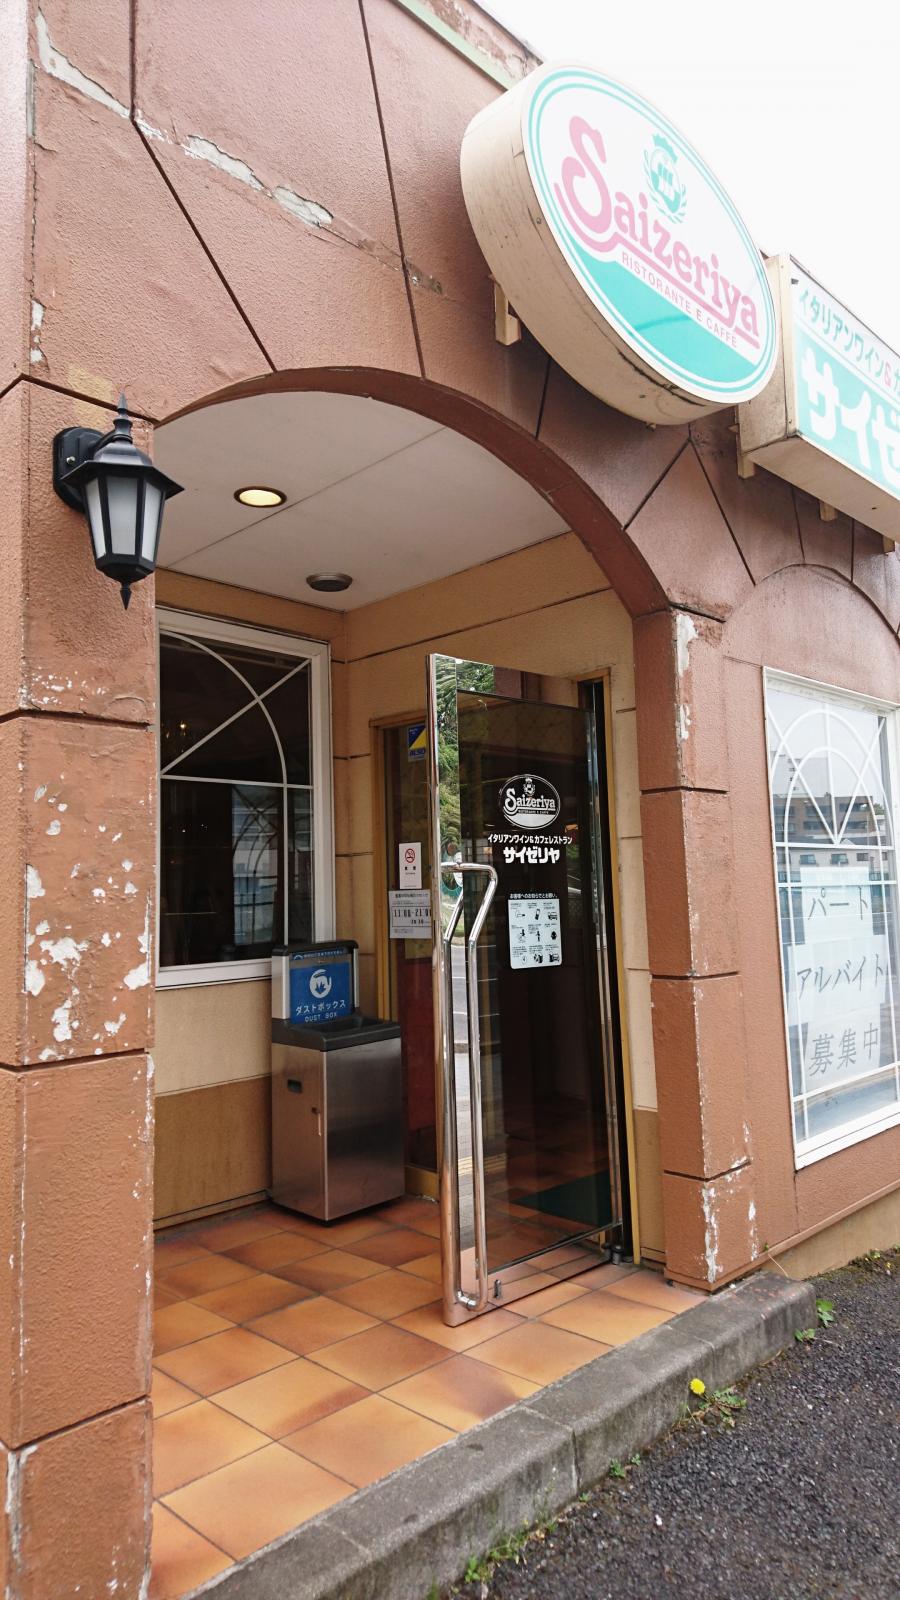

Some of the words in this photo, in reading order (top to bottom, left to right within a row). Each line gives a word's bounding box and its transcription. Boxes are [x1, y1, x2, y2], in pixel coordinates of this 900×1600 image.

[554, 115, 760, 350] Saizeriya
[621, 251, 692, 313] RISTORANTE
[695, 310, 703, 321] E
[706, 319, 738, 348] CAFFE
[503, 788, 556, 814] Saizeriya
[503, 846, 560, 863] サイゼリヤ
[807, 887, 868, 921] パート
[797, 954, 884, 1000] アルバイト
[296, 1000, 346, 1016] ダストボックス
[808, 1022, 879, 1077] 募集中
